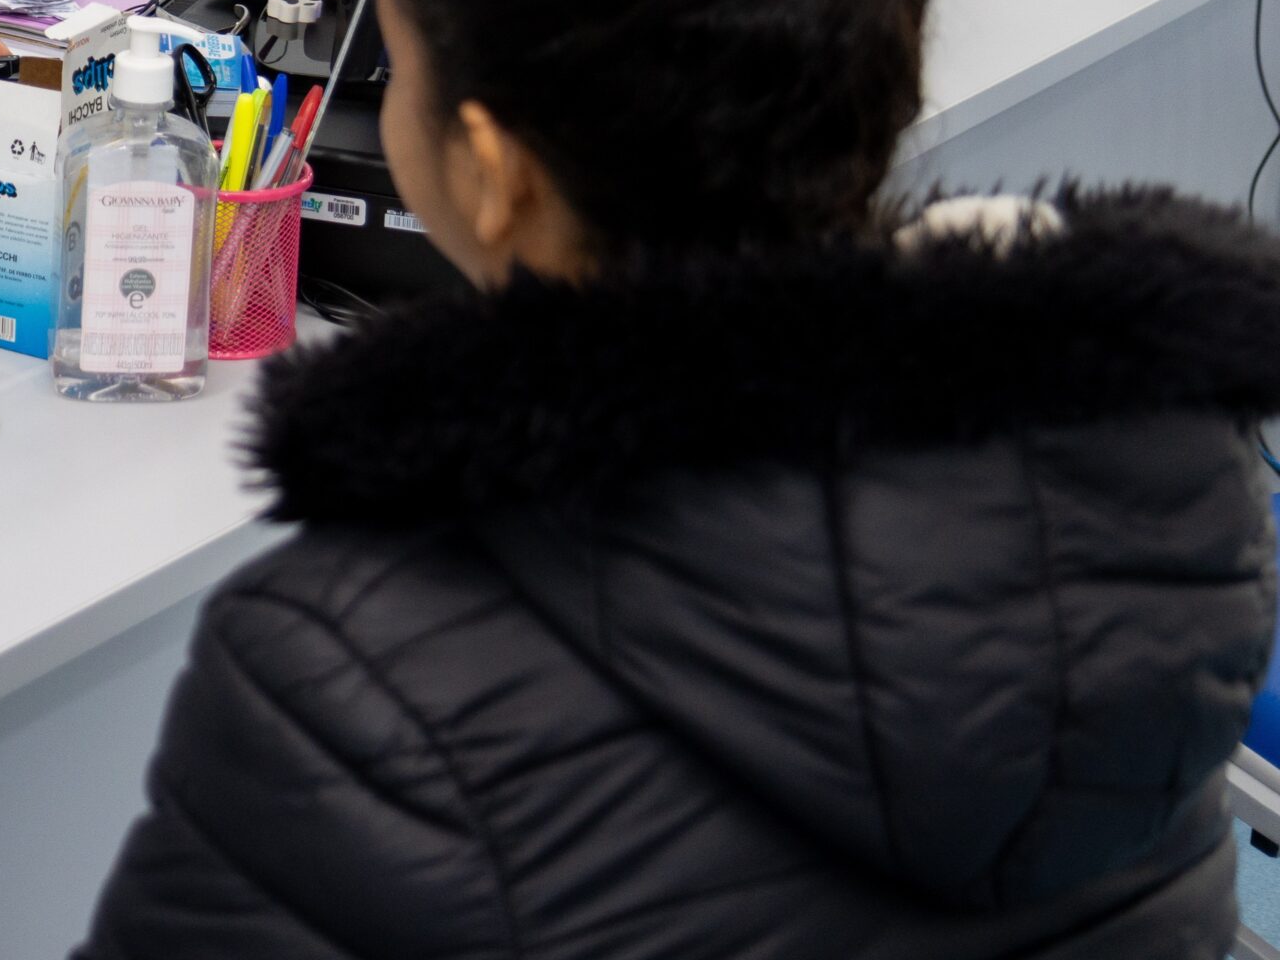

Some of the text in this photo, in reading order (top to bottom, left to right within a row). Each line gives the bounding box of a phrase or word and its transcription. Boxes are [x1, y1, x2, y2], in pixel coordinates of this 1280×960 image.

[68, 96, 103, 126] BACCHI
[101, 195, 185, 208] GIOVANNA BABY
[111, 232, 168, 240] HIGIENIZANTE
